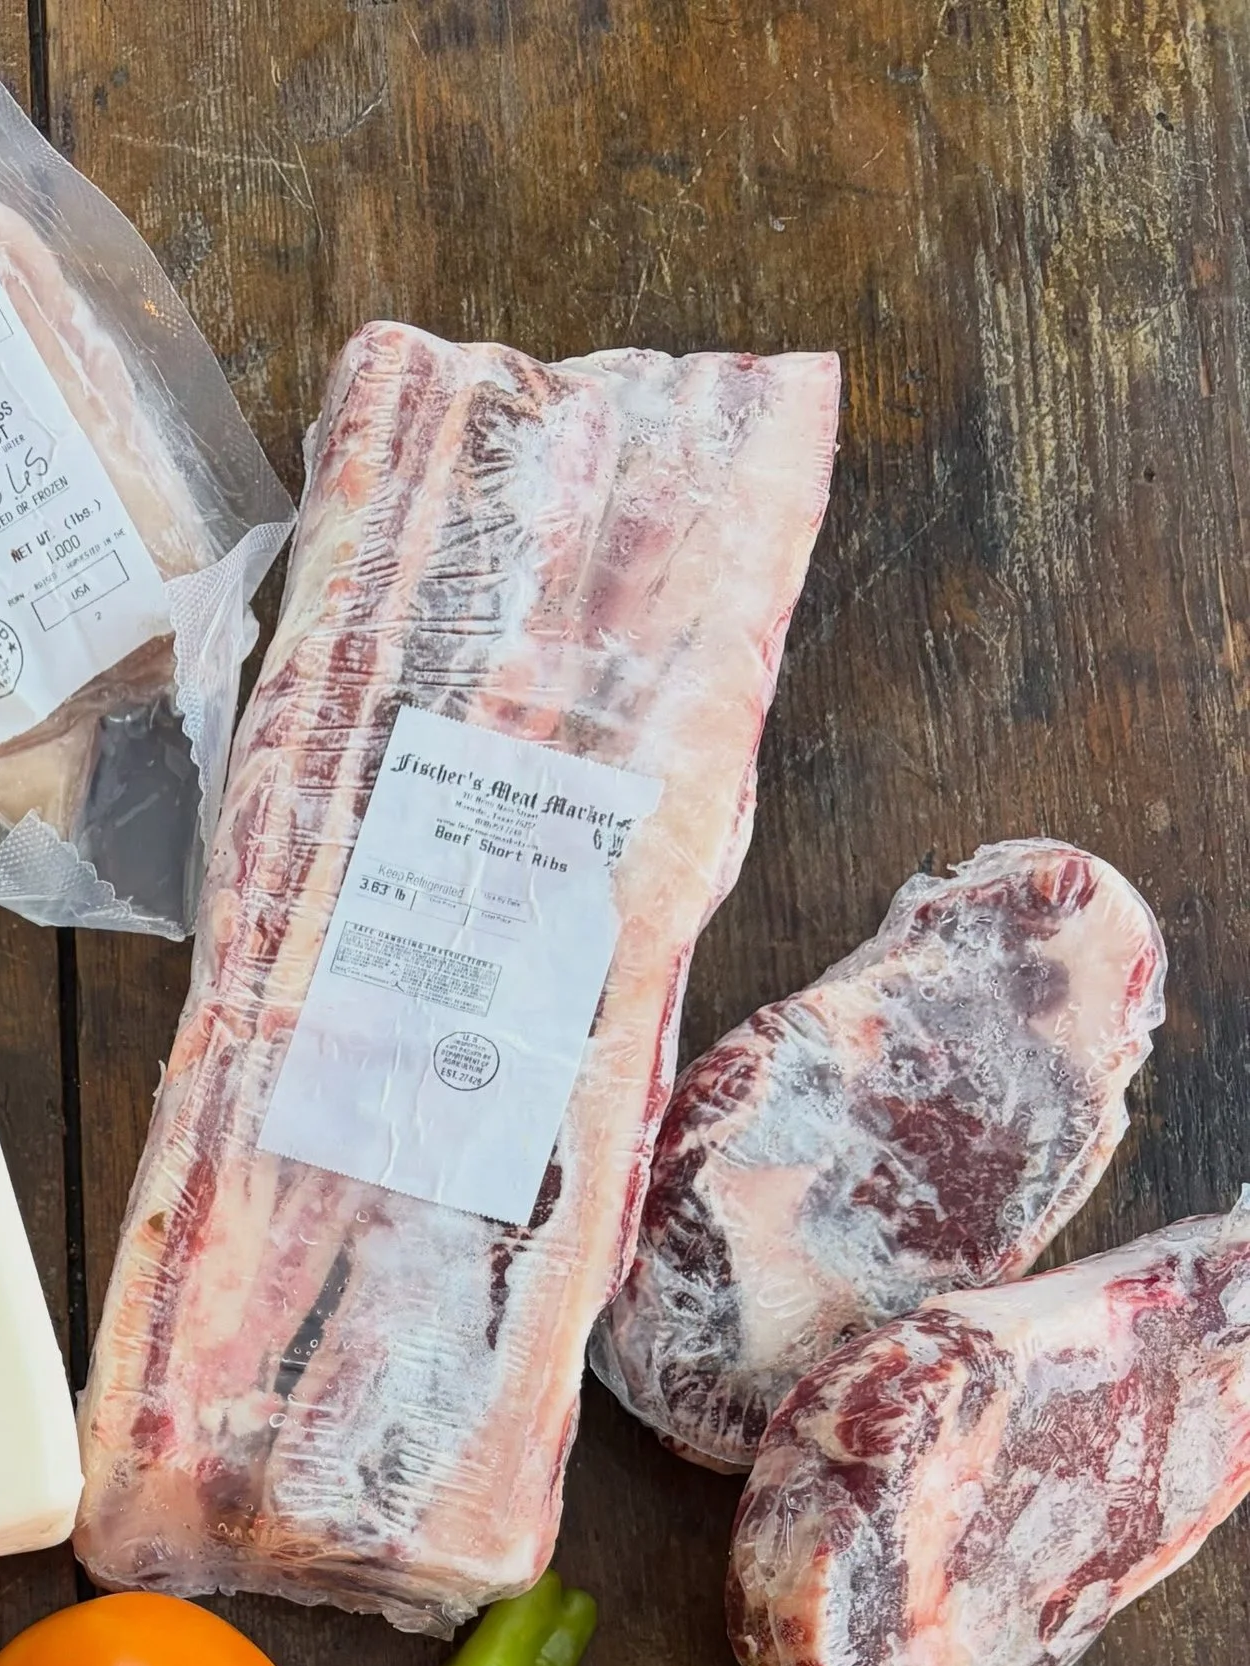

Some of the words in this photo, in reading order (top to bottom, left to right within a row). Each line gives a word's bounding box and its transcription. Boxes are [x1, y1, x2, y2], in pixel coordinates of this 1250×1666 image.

[15, 500, 30, 516] OR
[31, 475, 69, 506] FROZEN
[10, 542, 33, 564] NET
[46, 534, 81, 565] 1.000
[70, 583, 91, 600] USA
[390, 753, 485, 791] Fischer's
[485, 780, 539, 810] Meat
[434, 824, 472, 846] Beef
[478, 838, 523, 862] Short
[531, 852, 568, 873] Ribs
[359, 877, 390, 896] 3.63
[394, 887, 406, 901] lb
[377, 863, 405, 883] Keep
[405, 871, 466, 900] Refrigerated
